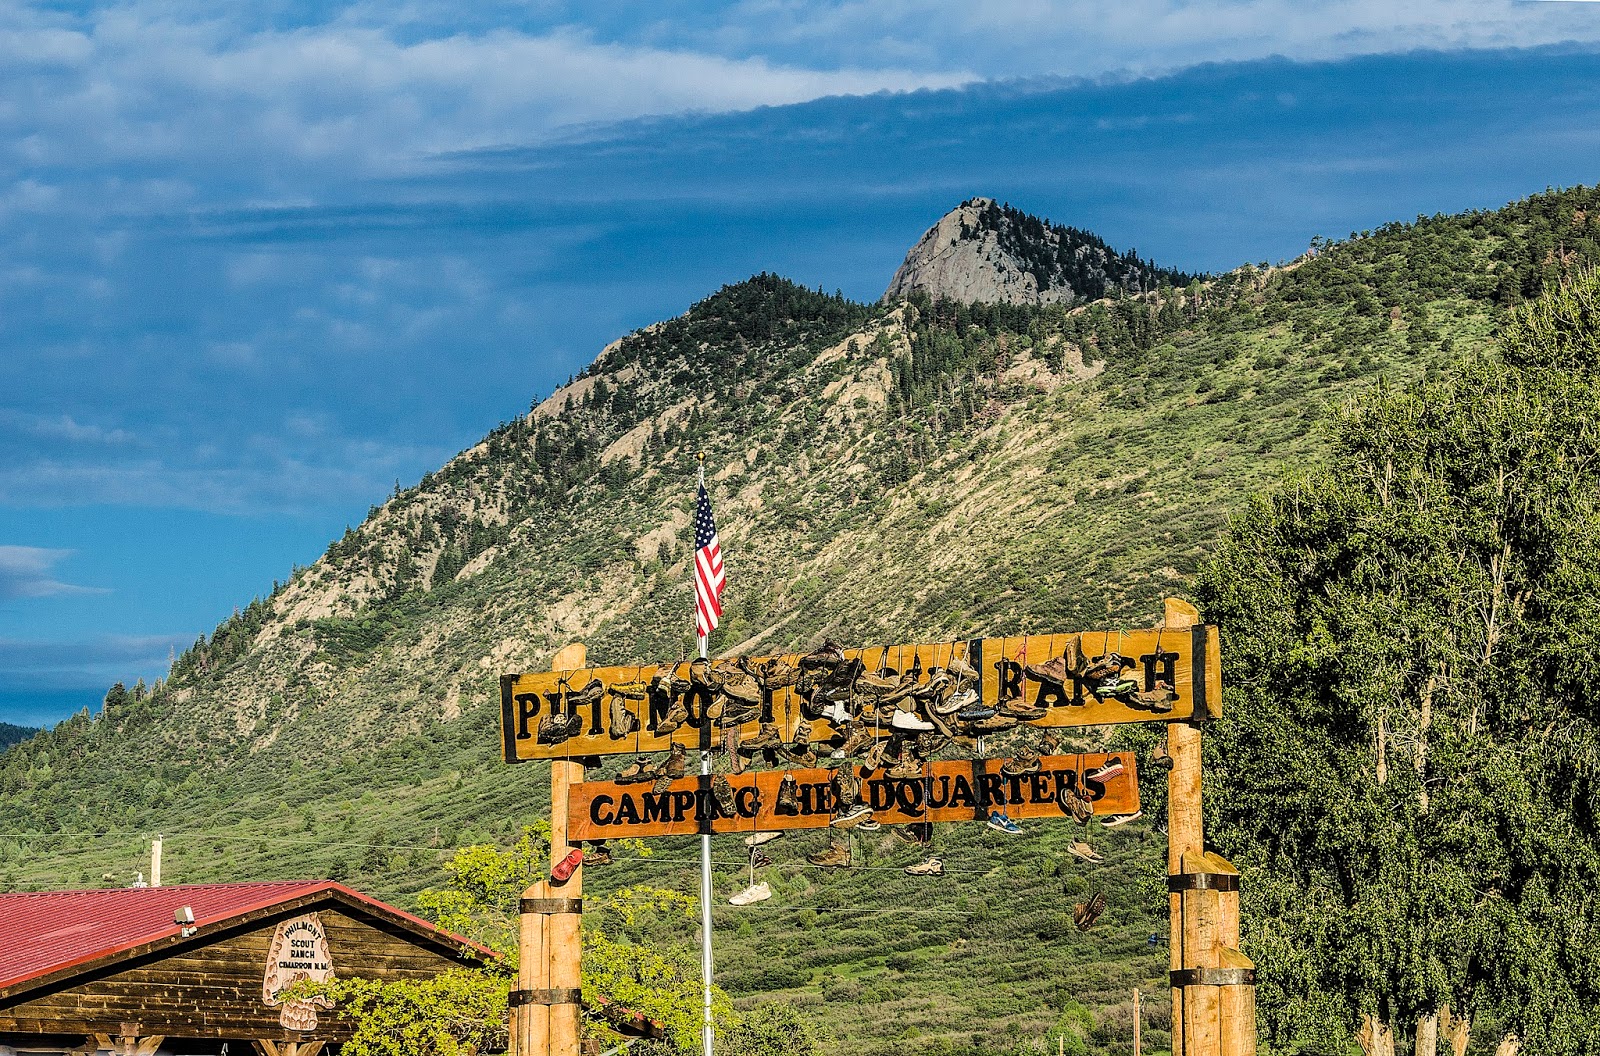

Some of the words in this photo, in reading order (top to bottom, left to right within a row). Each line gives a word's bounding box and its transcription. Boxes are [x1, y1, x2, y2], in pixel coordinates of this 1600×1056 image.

[514, 676, 782, 740] PHIMO
[994, 652, 1180, 707] RANH
[784, 768, 1106, 818] HEDQUARTERS
[284, 921, 322, 940] PHILMONT
[291, 940, 314, 948] SCOUT
[291, 950, 315, 958] RANCH
[279, 961, 312, 969] CIMARRON
